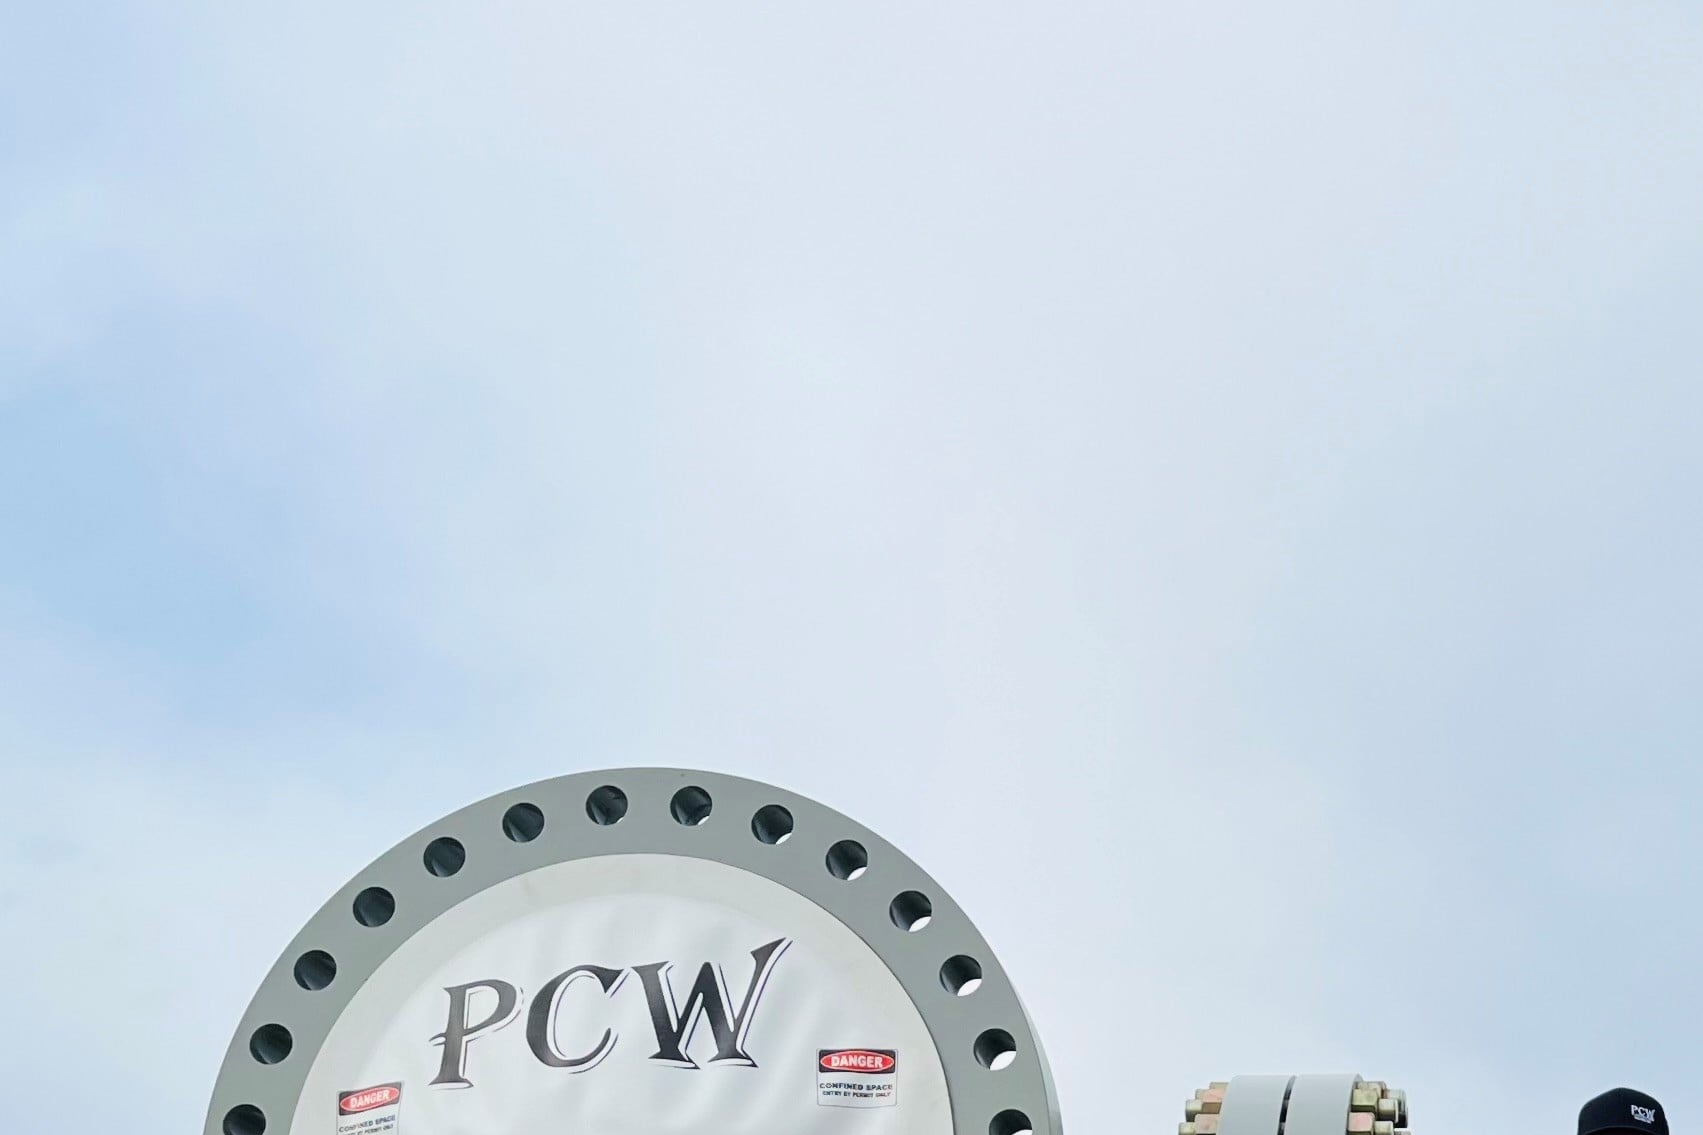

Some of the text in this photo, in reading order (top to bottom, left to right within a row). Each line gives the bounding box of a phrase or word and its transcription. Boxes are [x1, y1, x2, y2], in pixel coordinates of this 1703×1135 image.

[428, 937, 793, 1090] PCW
[830, 1055, 883, 1068] DANGER
[819, 1082, 864, 1091] CONFINED
[350, 1089, 390, 1108] DANGER
